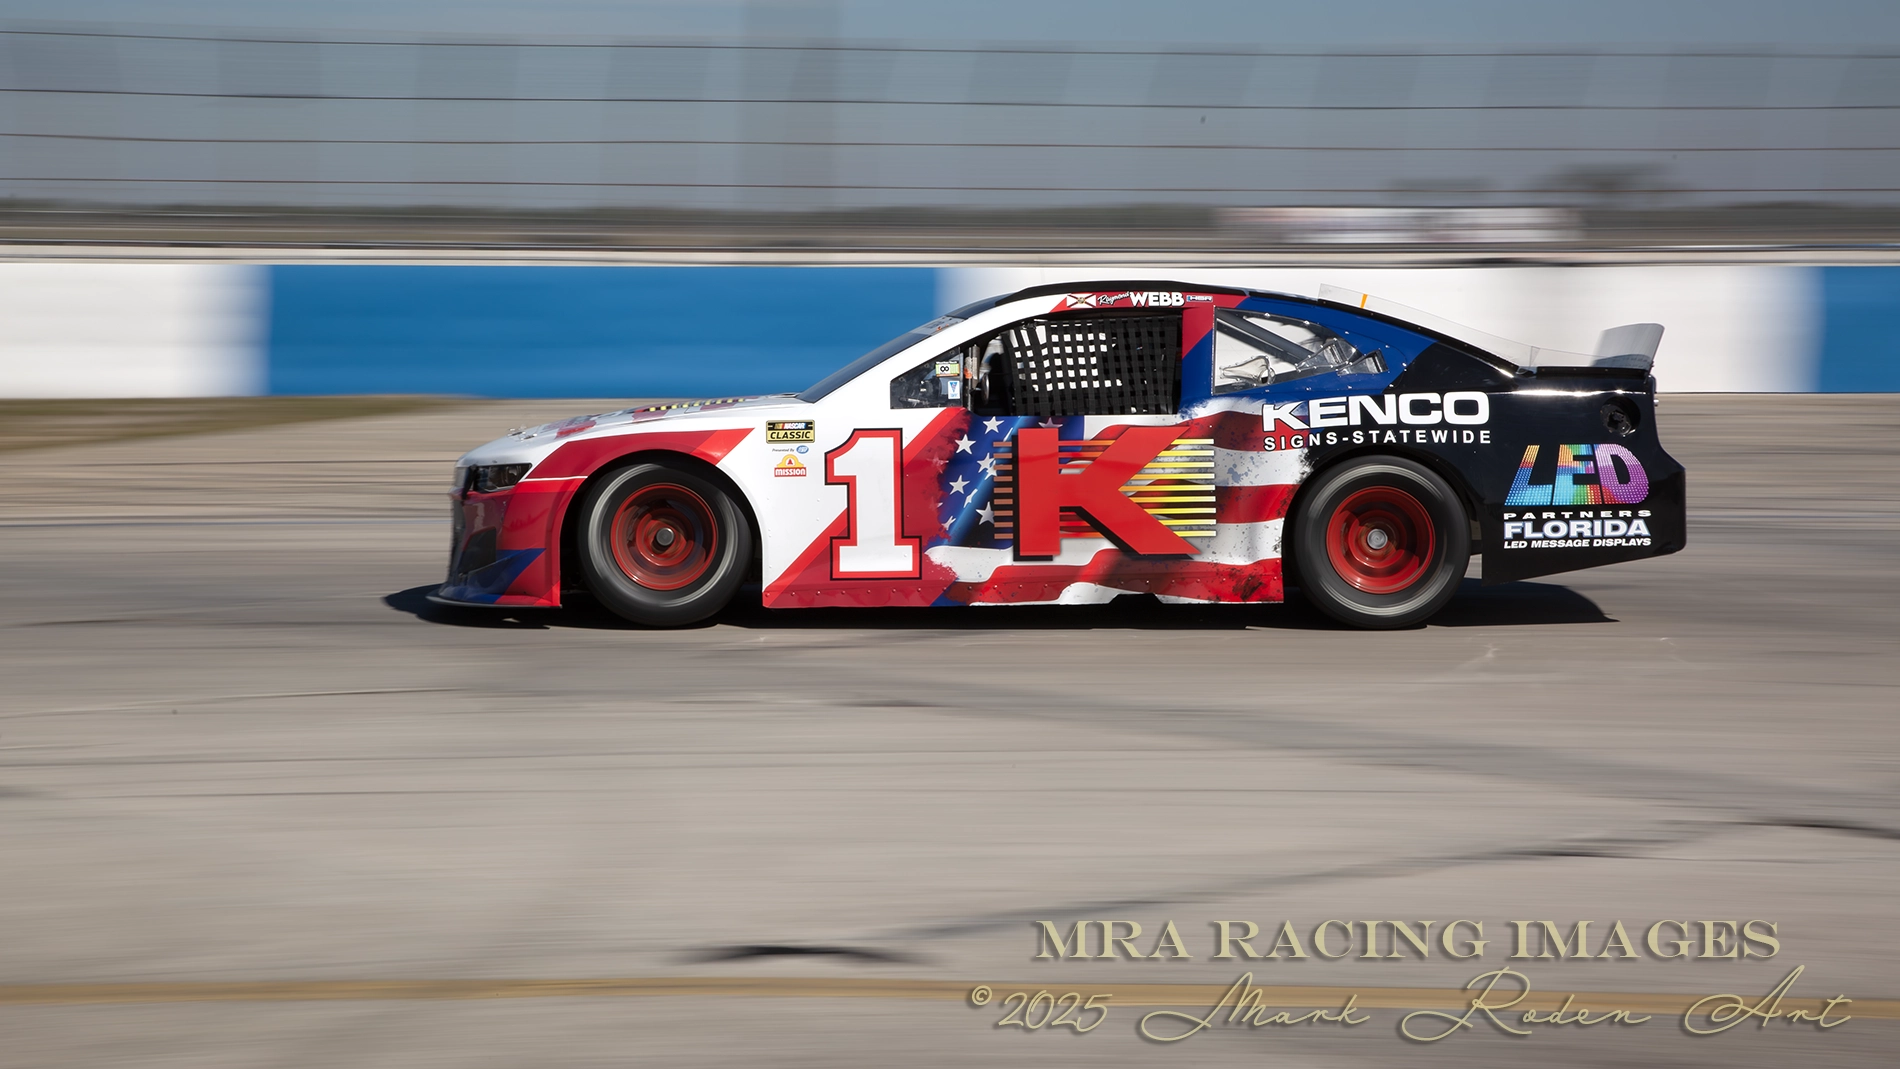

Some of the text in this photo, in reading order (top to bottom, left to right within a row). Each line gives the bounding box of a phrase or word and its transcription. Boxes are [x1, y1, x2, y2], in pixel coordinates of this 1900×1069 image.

[1129, 291, 1184, 307] WEBB
[1262, 391, 1490, 432] KENCO
[770, 431, 811, 439] CLASSIC
[1263, 430, 1491, 451] SIGNS-STATEWIDE
[1504, 443, 1650, 506] LED
[1013, 425, 1201, 560] K
[824, 428, 922, 580] 1
[1503, 510, 1652, 520] PARTNERS
[1503, 519, 1651, 539] FLORIDA
[1504, 538, 1652, 549] LED MESSAGE DISPLAYS
